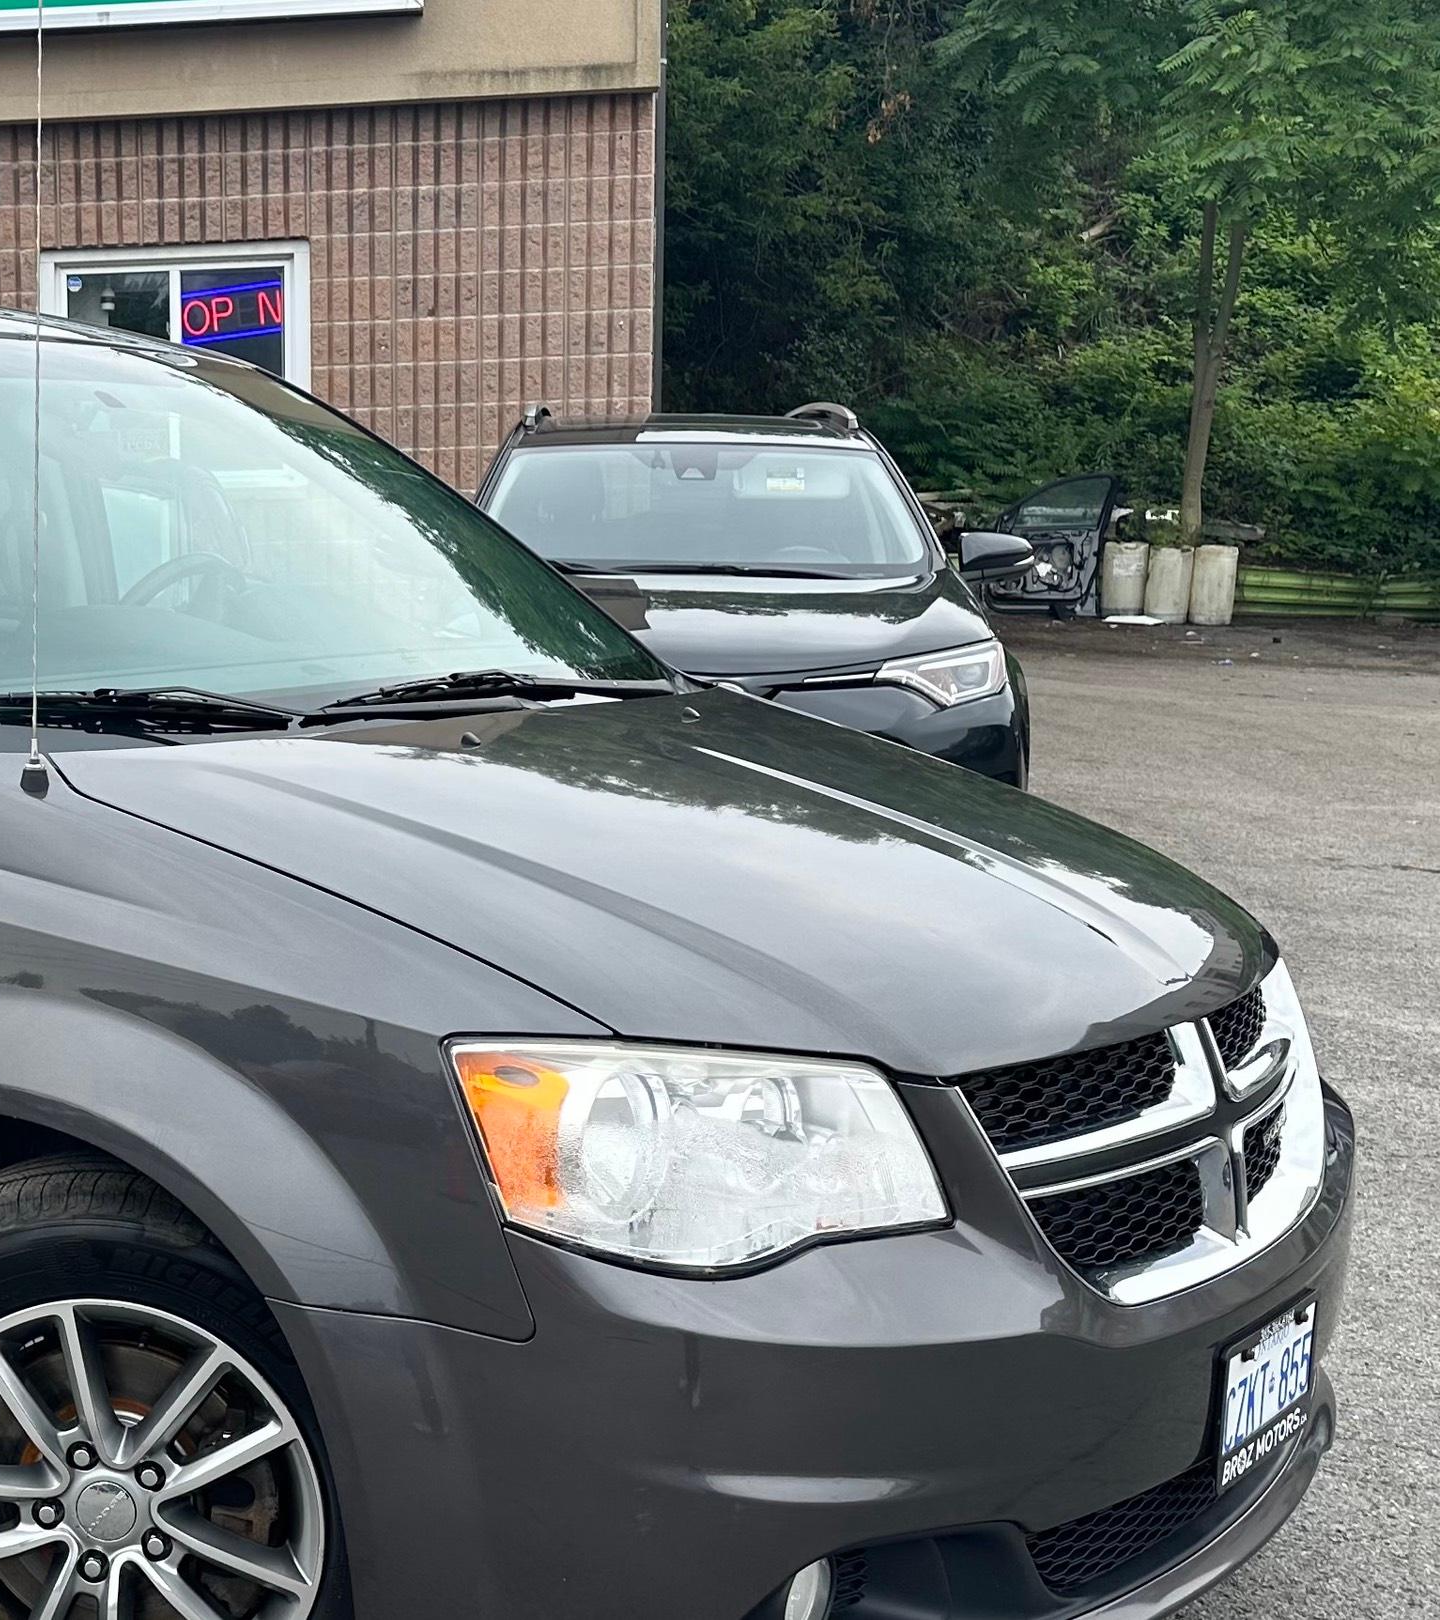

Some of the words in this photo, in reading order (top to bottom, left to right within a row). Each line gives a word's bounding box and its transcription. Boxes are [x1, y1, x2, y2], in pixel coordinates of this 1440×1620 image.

[182, 288, 282, 336] OPN
[1223, 1360, 1270, 1451] CZKT
[1278, 1333, 1312, 1410] 855
[1221, 1441, 1255, 1486] BROZ
